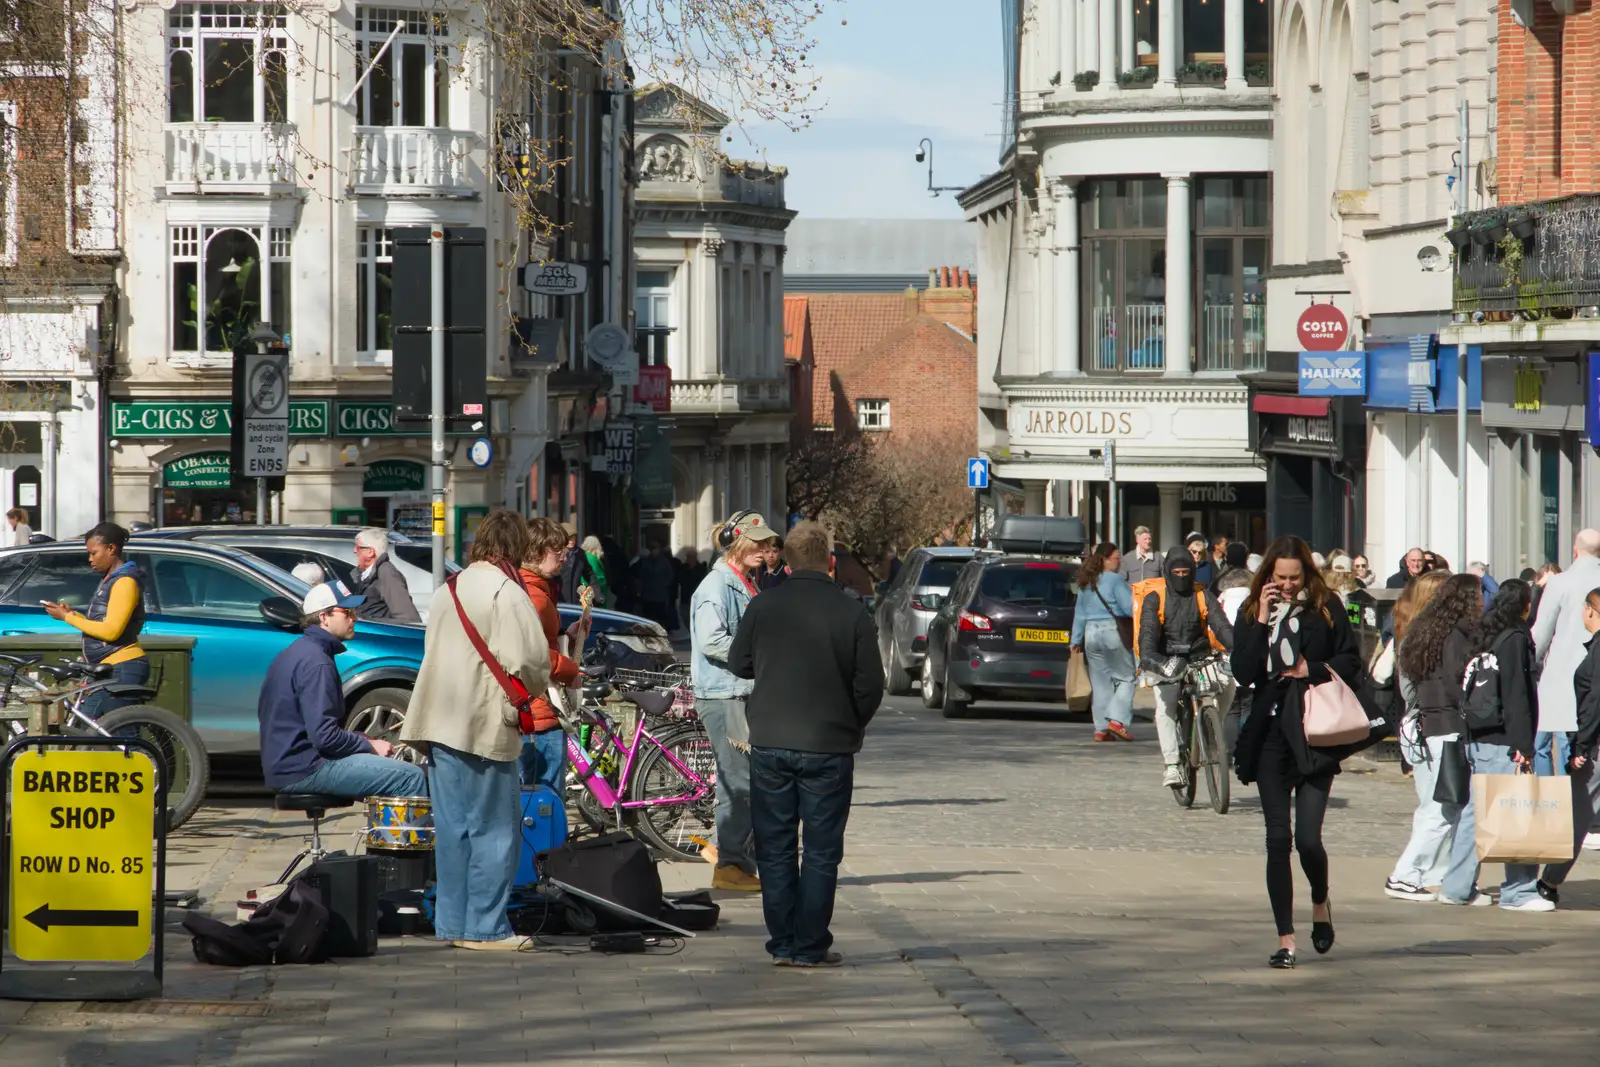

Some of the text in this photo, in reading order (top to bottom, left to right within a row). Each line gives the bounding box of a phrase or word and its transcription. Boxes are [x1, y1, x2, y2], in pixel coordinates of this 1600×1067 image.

[1302, 321, 1343, 332] COSTA
[1301, 368, 1362, 379] HALIFAX
[116, 408, 194, 430] E-CIGS
[199, 408, 219, 429] &
[1025, 410, 1132, 434] JARROLDS
[247, 422, 286, 432] Pedestrian
[249, 434, 284, 443] and cycle
[604, 429, 634, 447] WE
[257, 445, 276, 453] Zone
[605, 448, 633, 462] BUY
[249, 458, 283, 472] ENDS
[1020, 631, 1065, 641] VN60 DDL
[23, 770, 144, 794] BARBER'S
[1500, 799, 1558, 809] PRIMARK
[50, 806, 115, 829] SHOP
[20, 856, 144, 874] ROW D No. 85
